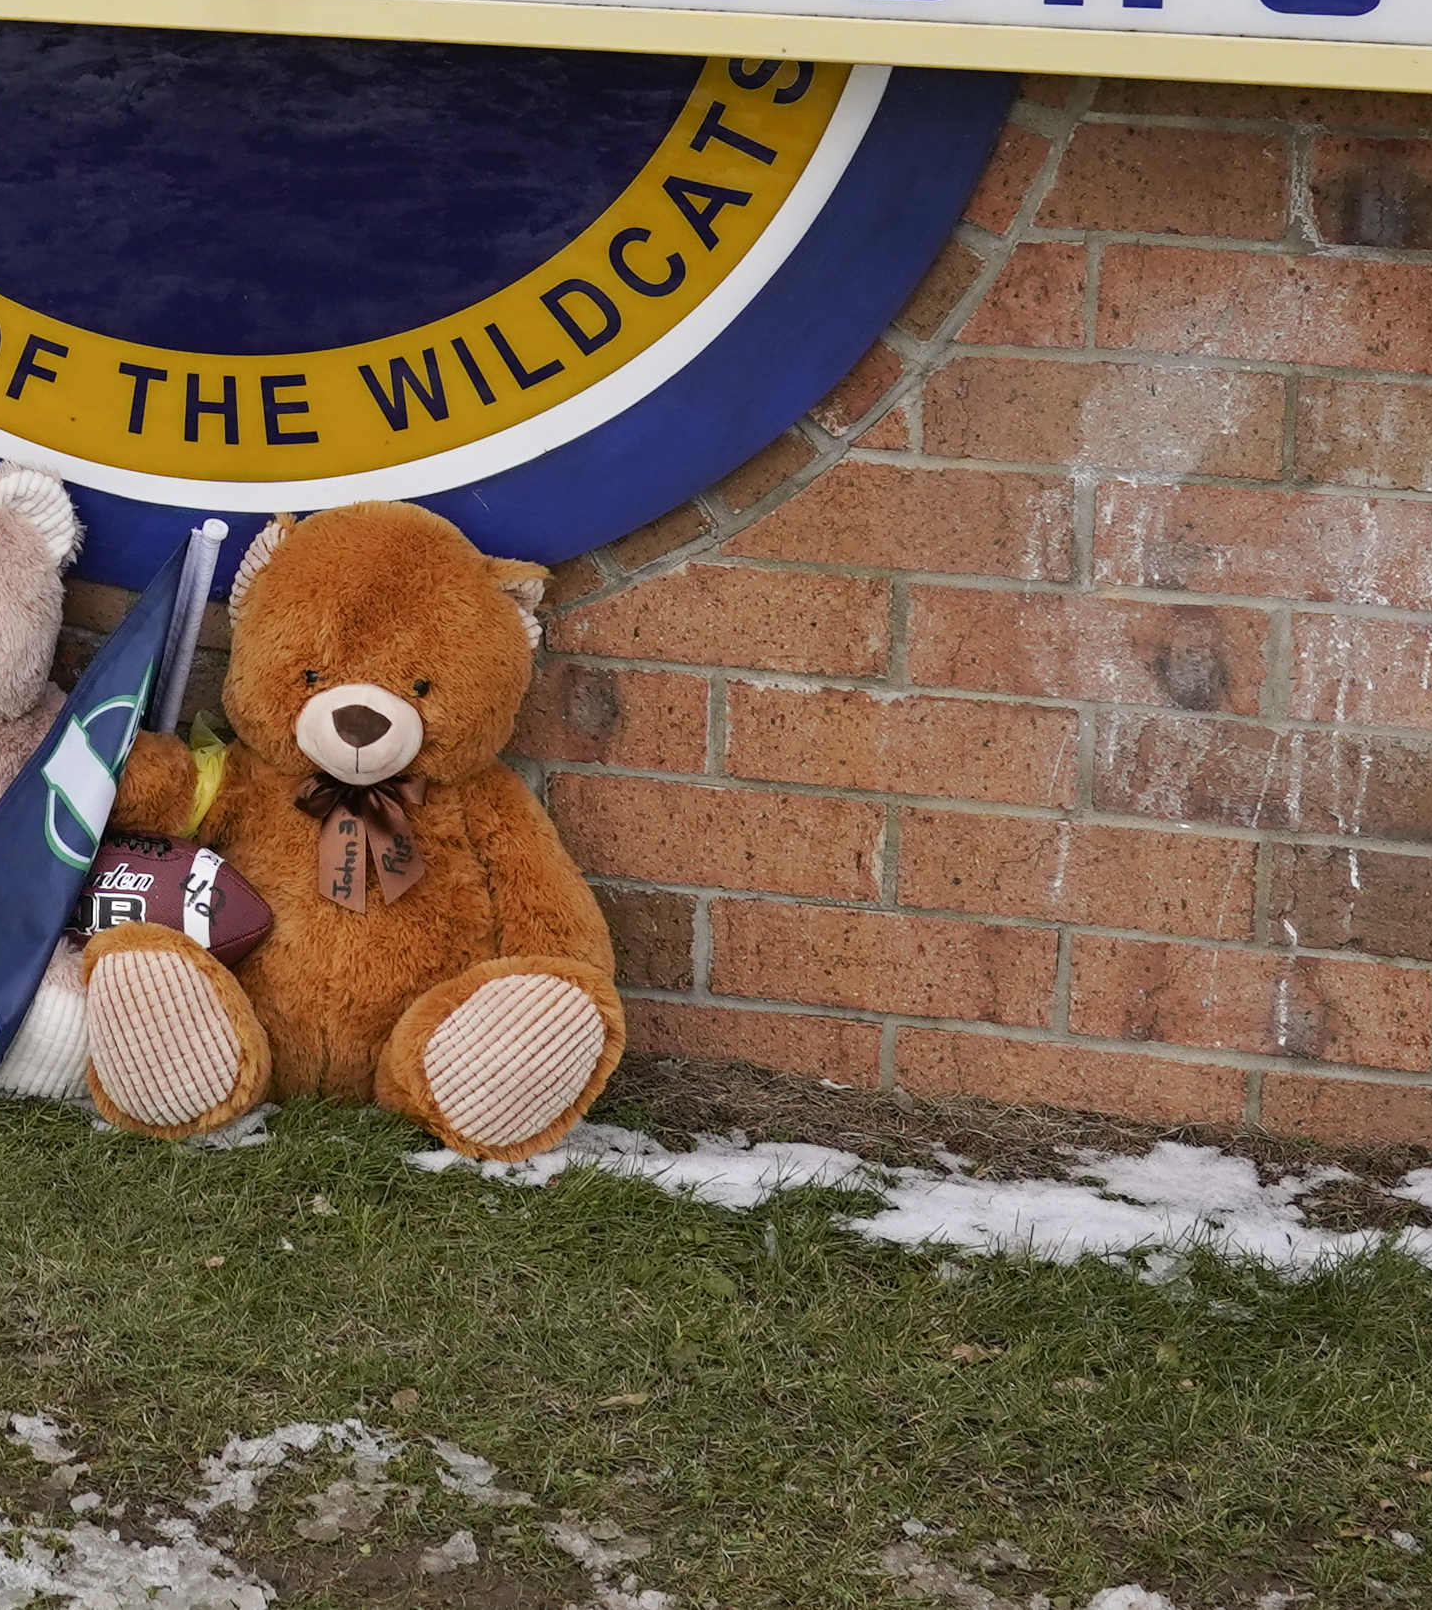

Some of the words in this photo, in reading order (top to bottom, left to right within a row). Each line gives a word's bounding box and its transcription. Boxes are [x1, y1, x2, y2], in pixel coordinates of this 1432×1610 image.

[116, 359, 323, 448] THE
[355, 57, 816, 434] WILDCATS
[331, 840, 360, 901] John
